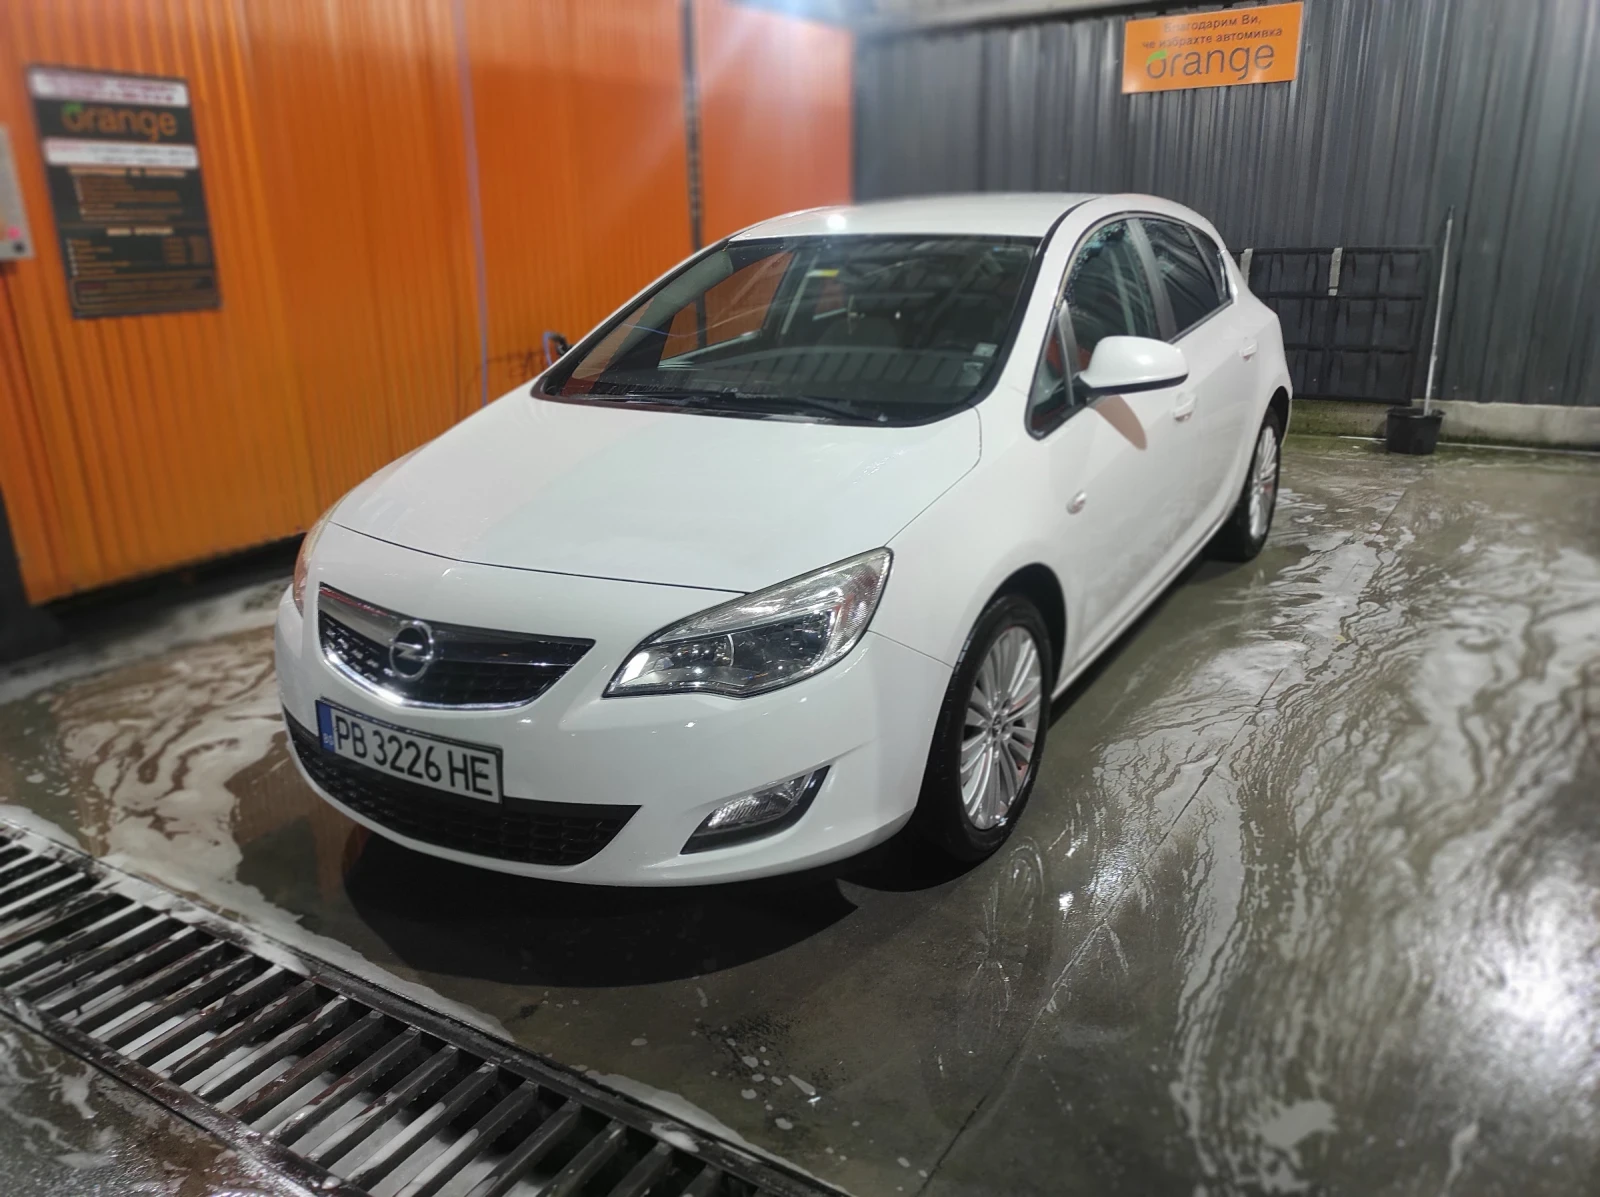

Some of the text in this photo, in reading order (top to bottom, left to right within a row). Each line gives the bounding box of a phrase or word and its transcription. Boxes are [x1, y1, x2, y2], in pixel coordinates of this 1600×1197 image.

[1142, 28, 1283, 49] че избрахте автомивка
[1146, 43, 1274, 80] orange
[62, 103, 177, 140] orange
[335, 714, 493, 796] PB 3226 HE
